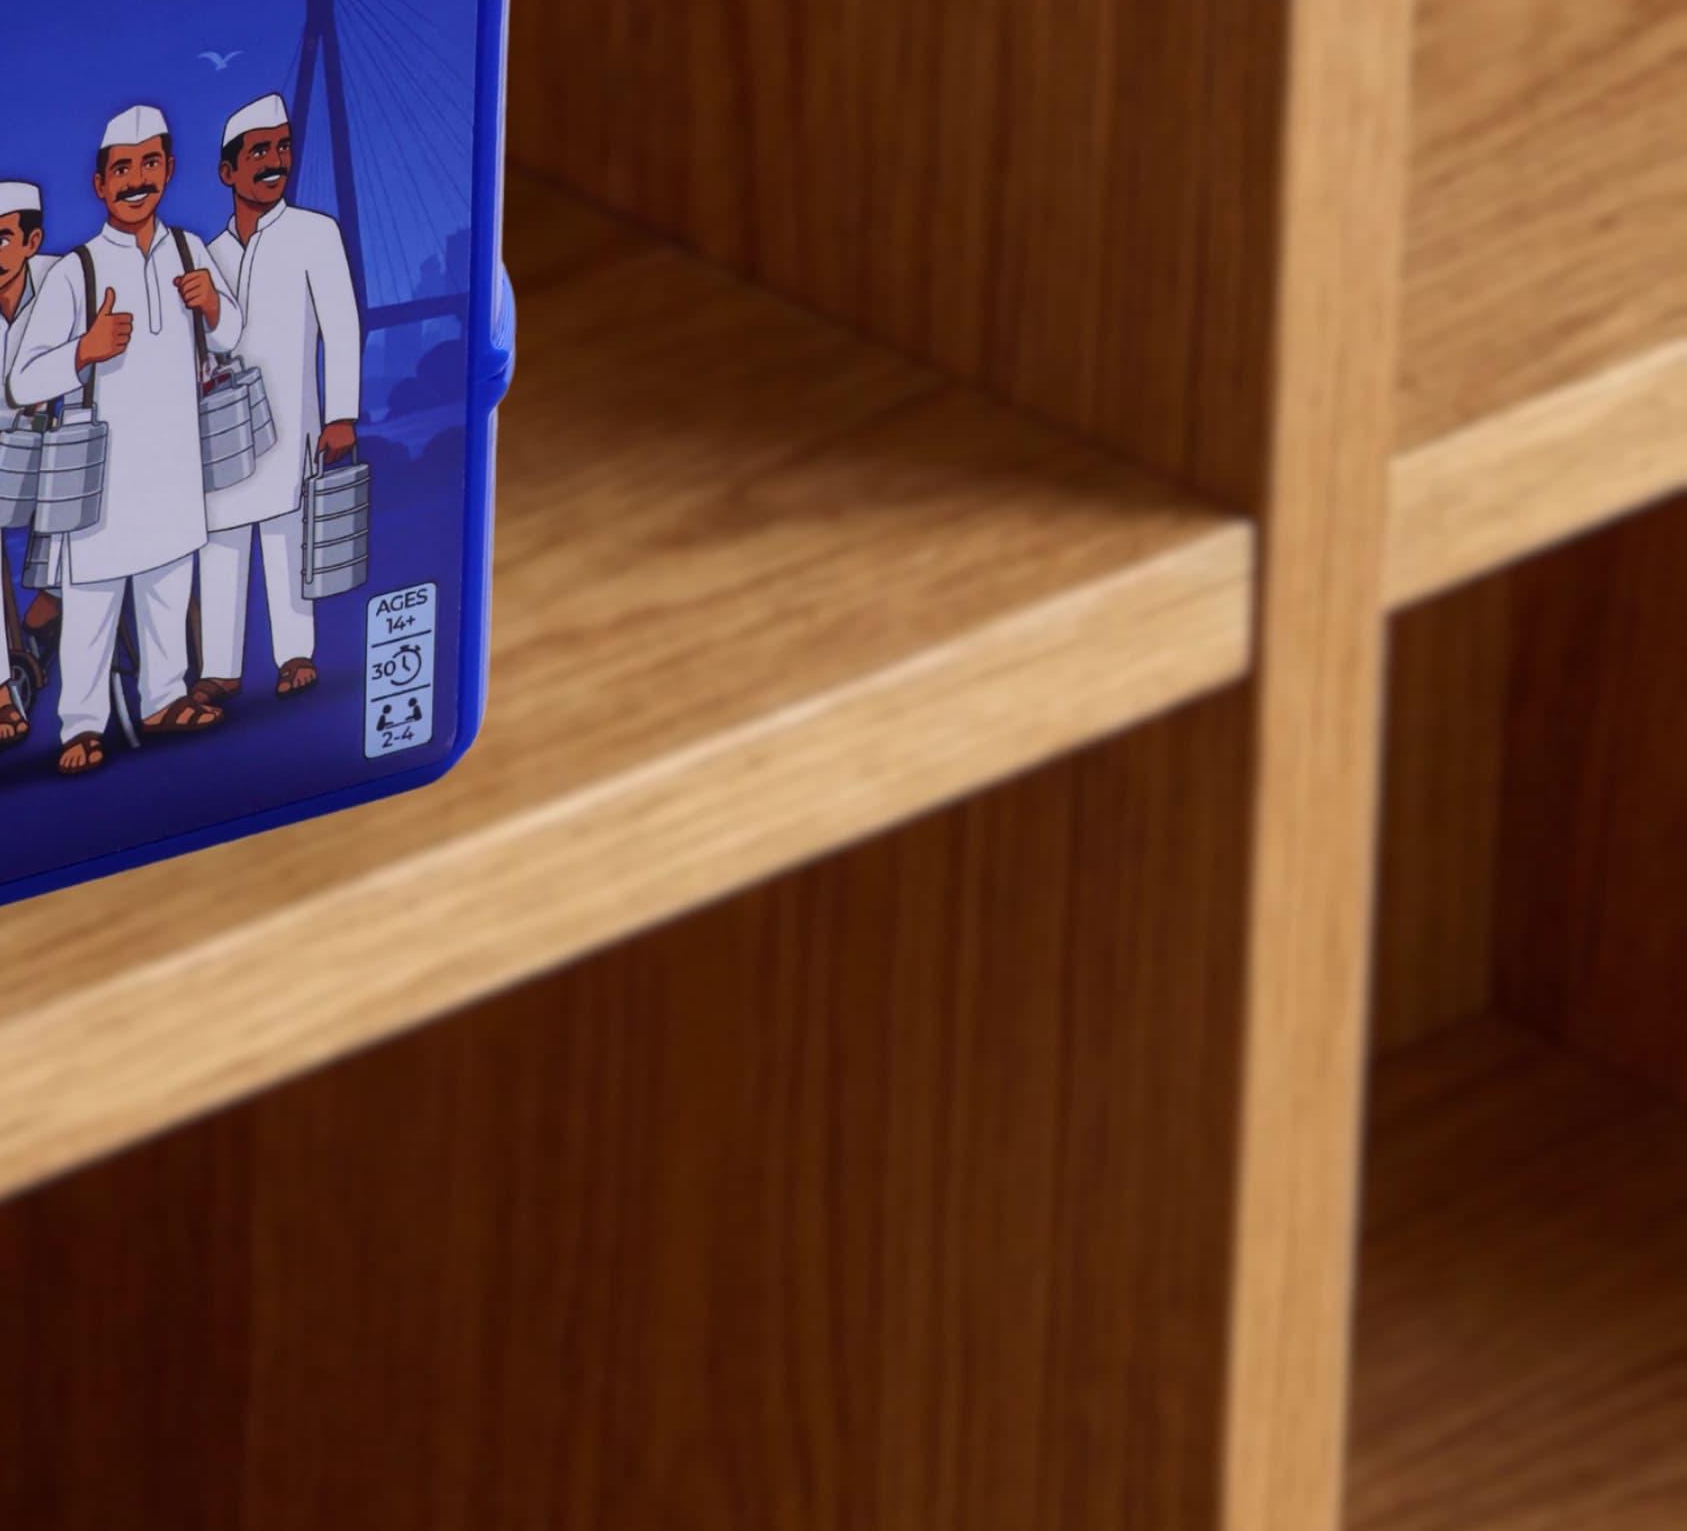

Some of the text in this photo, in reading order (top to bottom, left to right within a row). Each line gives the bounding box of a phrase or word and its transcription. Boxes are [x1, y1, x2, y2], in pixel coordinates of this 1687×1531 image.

[375, 588, 428, 617] AGES
[385, 614, 416, 634] 14+
[371, 660, 396, 681] 30
[381, 726, 414, 748] 2-4
